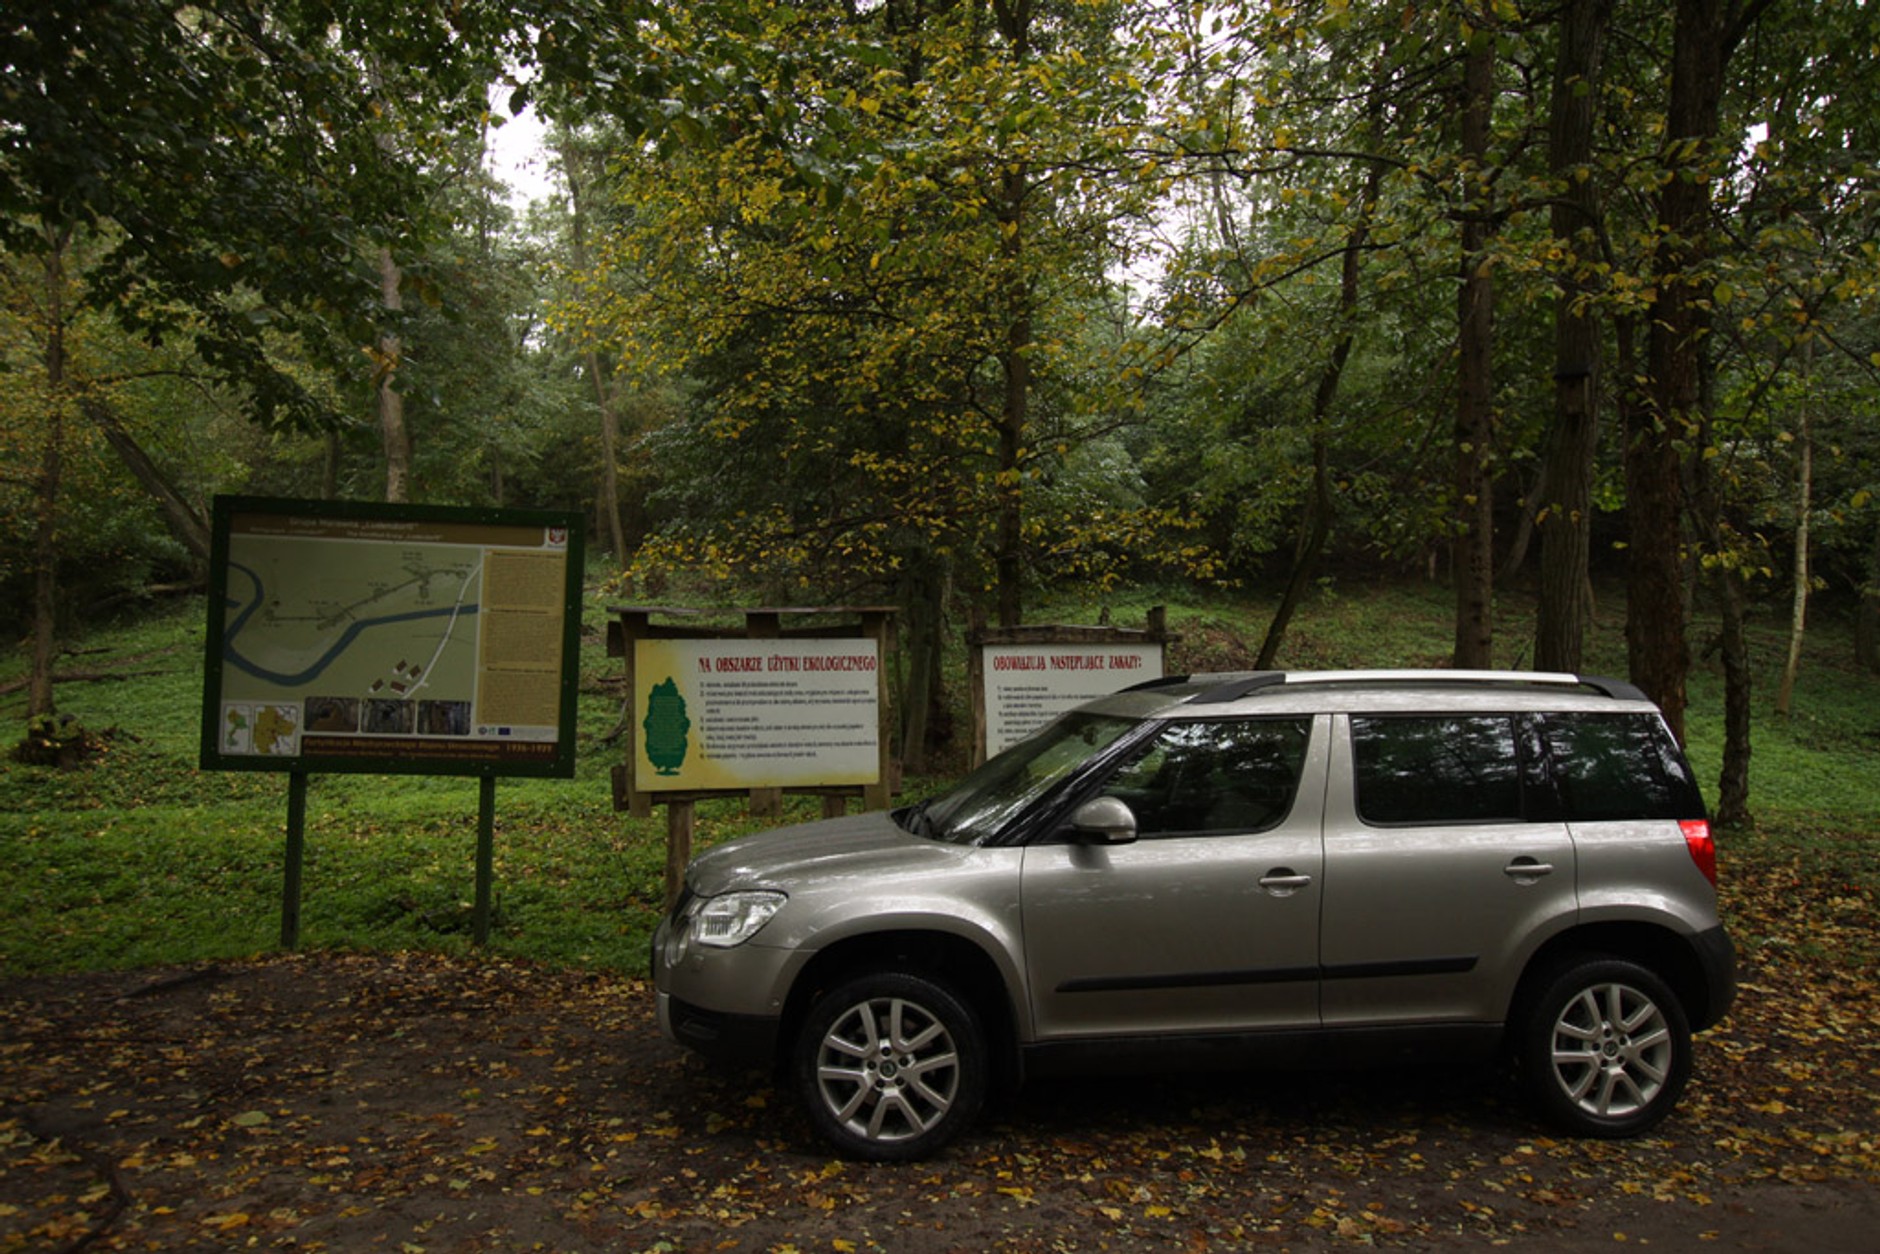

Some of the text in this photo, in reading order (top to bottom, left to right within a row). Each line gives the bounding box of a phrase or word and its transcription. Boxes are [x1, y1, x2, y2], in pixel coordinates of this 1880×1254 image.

[698, 654, 876, 672] NA OBSZARZE UŻYTKU EKOLOGICZNEGO
[1109, 655, 1142, 670] ZAKAZY:
